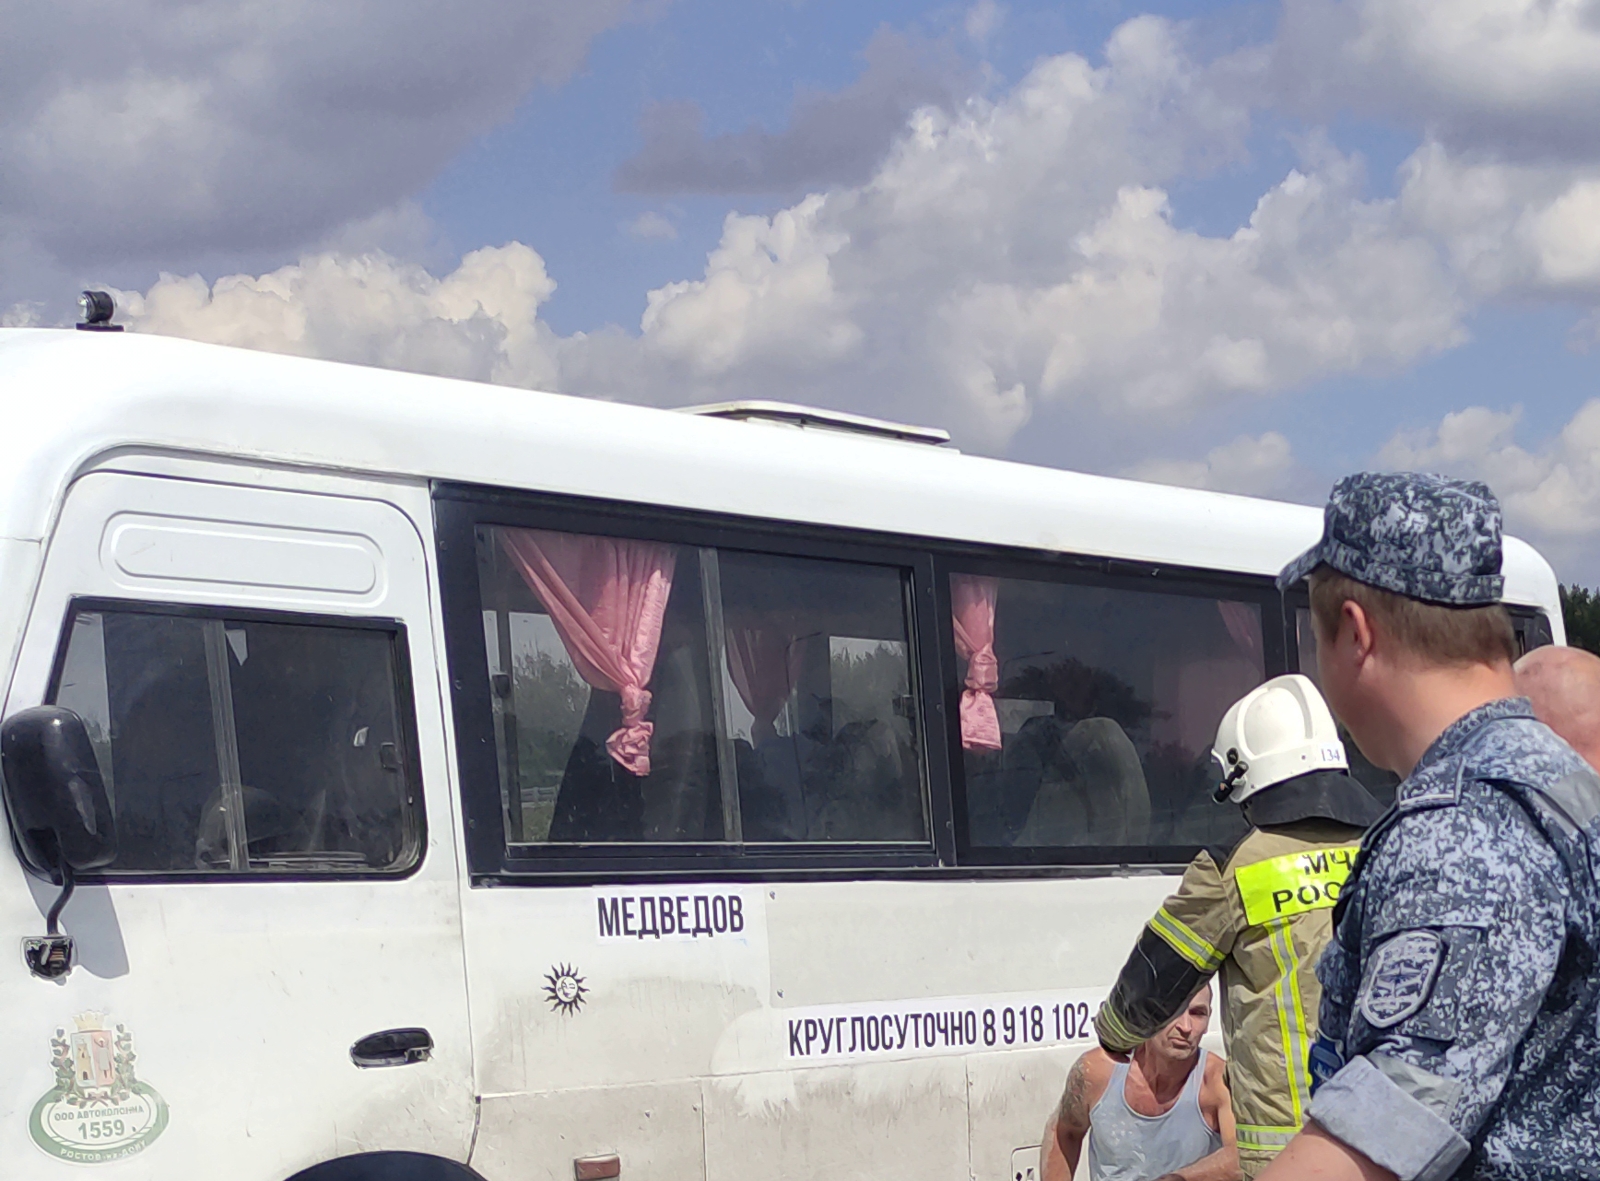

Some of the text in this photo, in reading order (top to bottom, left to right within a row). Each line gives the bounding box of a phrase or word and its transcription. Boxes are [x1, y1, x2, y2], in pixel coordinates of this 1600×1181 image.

[1320, 748, 1340, 761] 134
[597, 895, 744, 939] МЕДВЕДОВ
[788, 1010, 976, 1057] КРУГЛОСУТОЧНО
[983, 1009, 996, 1046] 8
[1003, 1005, 1043, 1044] 918
[54, 1112, 74, 1121] ООО
[78, 1120, 125, 1139] 1559
